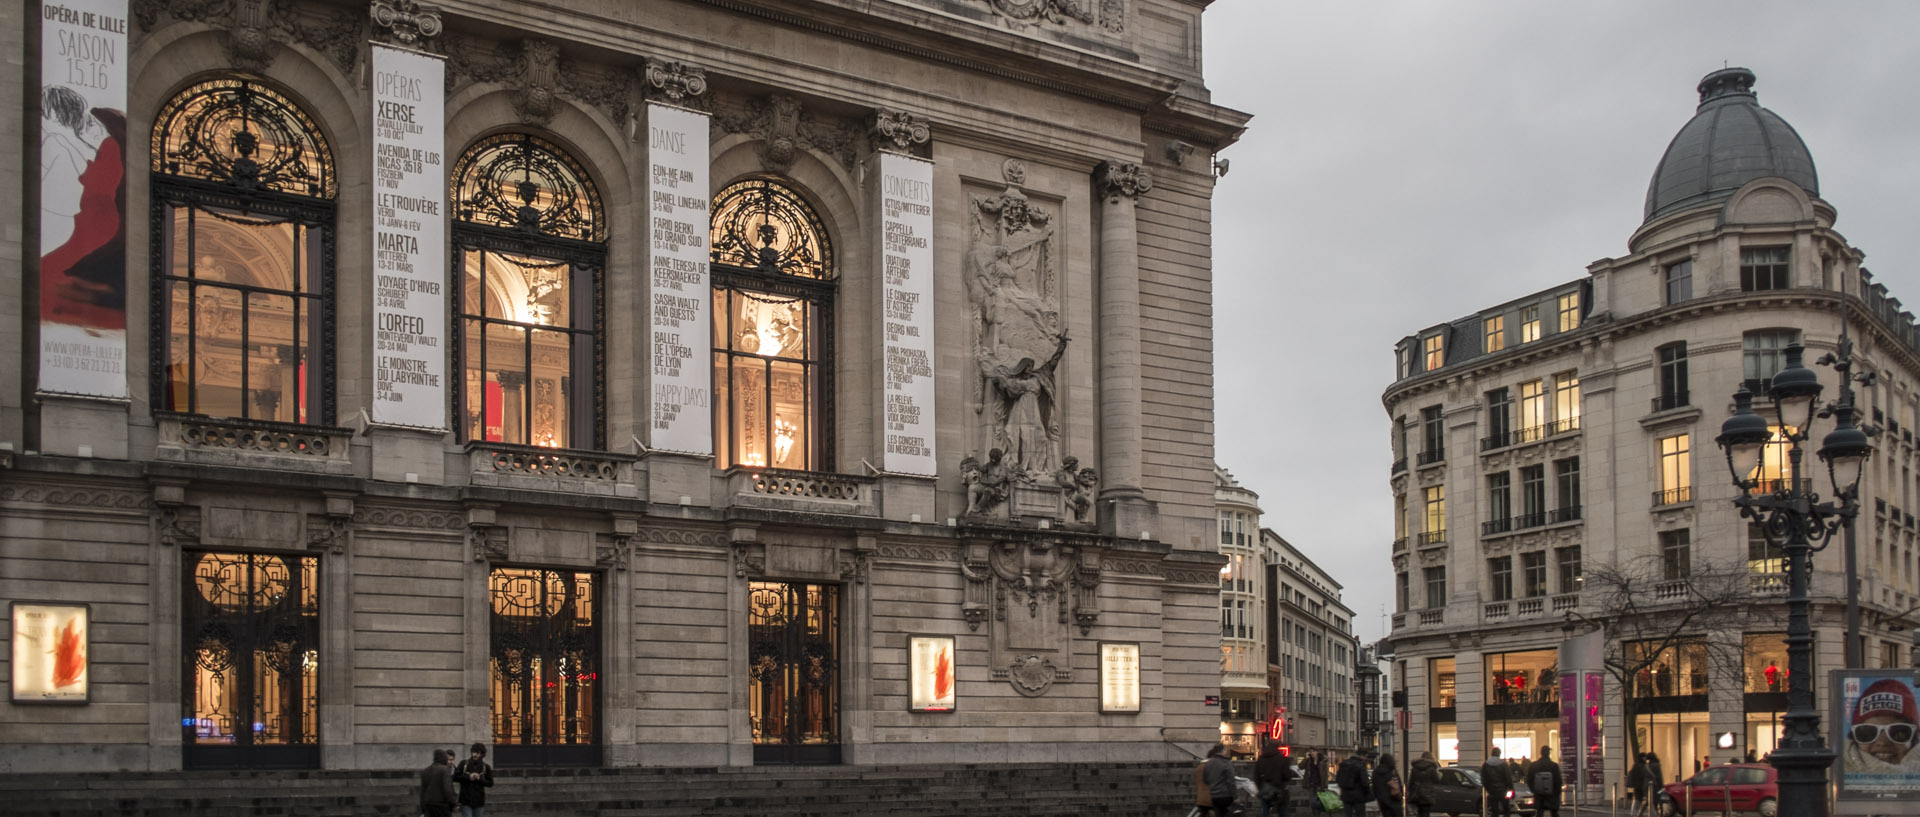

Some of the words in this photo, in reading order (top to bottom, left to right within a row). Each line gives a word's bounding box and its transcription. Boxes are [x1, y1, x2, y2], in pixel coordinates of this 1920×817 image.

[44, 4, 79, 25] OPÉRA
[83, 12, 96, 28] DE
[99, 15, 125, 34] LILLE
[59, 29, 114, 64] SAISON
[66, 58, 108, 90] 15.16
[377, 70, 421, 102] OPÉRAS
[378, 100, 415, 123] XERSE
[377, 128, 391, 139] 2-10
[392, 131, 404, 140] OCT
[652, 127, 686, 154] DANSE
[377, 143, 410, 160] AVENIDA
[412, 149, 423, 162] DE
[425, 152, 440, 165] LOS
[377, 156, 401, 170] INCAS
[403, 160, 422, 174] 3518
[377, 168, 403, 180] FISZBEIN
[653, 164, 678, 180] EUN-ME
[680, 170, 694, 182] AHN
[378, 178, 384, 187] 17
[386, 179, 399, 189] NOV
[668, 179, 678, 189] OCT
[885, 175, 929, 202] CONCERTS
[377, 193, 389, 207] LE
[391, 196, 439, 216] TROUVÈRE
[653, 190, 676, 206] DANIEL
[678, 196, 706, 210] LINEHAN
[377, 207, 395, 217] VERDI
[663, 204, 673, 213] NOV
[891, 210, 899, 218] NOV
[378, 217, 385, 225] 14
[386, 218, 408, 229] JANV-6
[654, 217, 672, 231] FARID
[674, 221, 693, 235] BERKI
[886, 221, 913, 236] CAPPELLA
[378, 232, 418, 255] MARTA
[654, 229, 663, 240] AU
[665, 231, 686, 245] GRAND
[688, 234, 702, 247] SUD
[654, 241, 668, 250] 13-14
[669, 243, 679, 252] NOV
[898, 245, 906, 254] NOV
[377, 250, 408, 262] MITTERER
[886, 255, 910, 269] QUATUOR
[378, 260, 394, 270] 13-21
[396, 262, 413, 273] MARS
[654, 256, 671, 268] ANNE
[672, 258, 697, 272] TERESA
[698, 262, 707, 274] DE
[654, 268, 701, 284] KEERSMAEKER
[886, 265, 909, 280] ARTEMIS
[377, 275, 408, 290] VOYAGE
[410, 280, 440, 295] D'HIVER
[669, 282, 684, 291] AVRIL
[377, 288, 409, 300] SCHUBERT
[887, 288, 893, 299] LE
[895, 289, 920, 303] CONCERT
[377, 297, 388, 307] 3-6
[389, 299, 406, 309] AVRIL
[654, 293, 676, 306] SASHA
[677, 297, 699, 310] WALTZ
[655, 305, 668, 317] AND
[670, 307, 695, 321] GUESTS
[899, 312, 911, 321] MARS
[378, 312, 423, 335] L'ORFEO
[671, 319, 679, 328] MAI
[887, 322, 905, 335] GEORG
[906, 326, 920, 337] NIGL
[655, 332, 680, 345] BALLET
[377, 341, 394, 350] 20-24
[397, 342, 407, 352] MAI
[655, 344, 663, 355] DE
[665, 344, 692, 358] L'OPÉRA
[887, 345, 899, 355] ANNA
[378, 356, 387, 368] LE
[390, 357, 427, 373] MONSTRE
[655, 355, 663, 366] DE
[665, 356, 681, 368] LYON
[668, 368, 679, 377] JUIN
[887, 364, 904, 374] PASCAL
[378, 369, 388, 381] DU
[391, 370, 439, 387] LABYRINTHE
[893, 373, 913, 384] FRIENDS
[377, 381, 393, 391] DOVE
[377, 391, 387, 400] 3-4
[389, 393, 403, 402] JUIN
[655, 384, 681, 403] HAPPY
[683, 386, 707, 408] DAYS!
[888, 394, 894, 403] LA
[655, 403, 669, 412] 21-22
[670, 403, 681, 413] NOV
[888, 404, 897, 413] DES
[898, 405, 920, 415] GRANDES
[655, 412, 660, 420] 31
[662, 412, 676, 421] JANV
[888, 413, 899, 421] VOIX
[900, 414, 919, 424] RUSSES
[659, 421, 669, 429] MAI
[894, 423, 904, 431] JUIN
[888, 435, 897, 444] LES
[898, 436, 924, 447] CONCERTS
[888, 444, 894, 453] DU
[896, 445, 920, 455] MERCREDI
